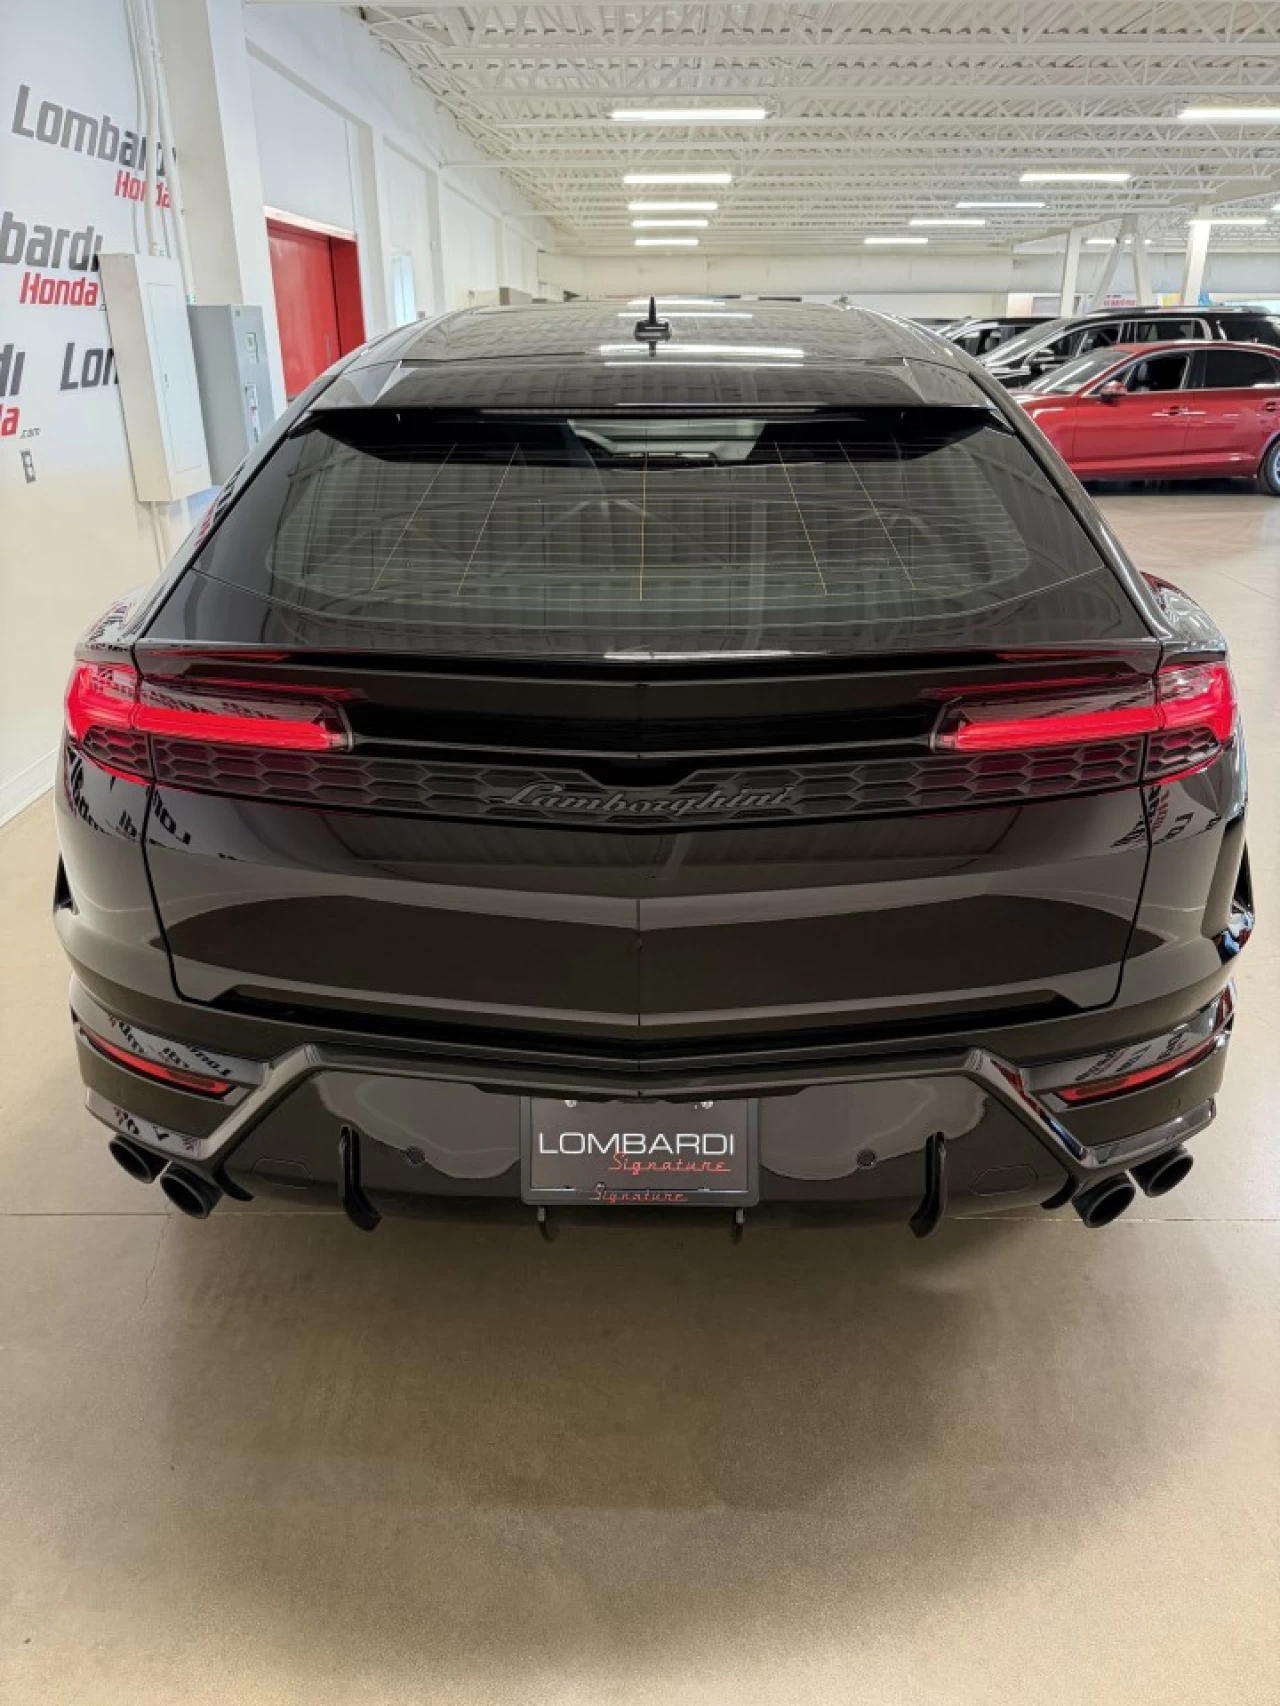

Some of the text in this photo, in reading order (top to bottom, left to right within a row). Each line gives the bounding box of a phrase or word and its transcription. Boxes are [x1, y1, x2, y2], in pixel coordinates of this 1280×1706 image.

[11, 84, 177, 177] Lombar
[19, 271, 99, 306] Honda
[488, 780, 796, 818] Lamborghini
[538, 1132, 735, 1156] LOMBARDI
[607, 1151, 732, 1176] Signature
[590, 1182, 689, 1204] Signature
